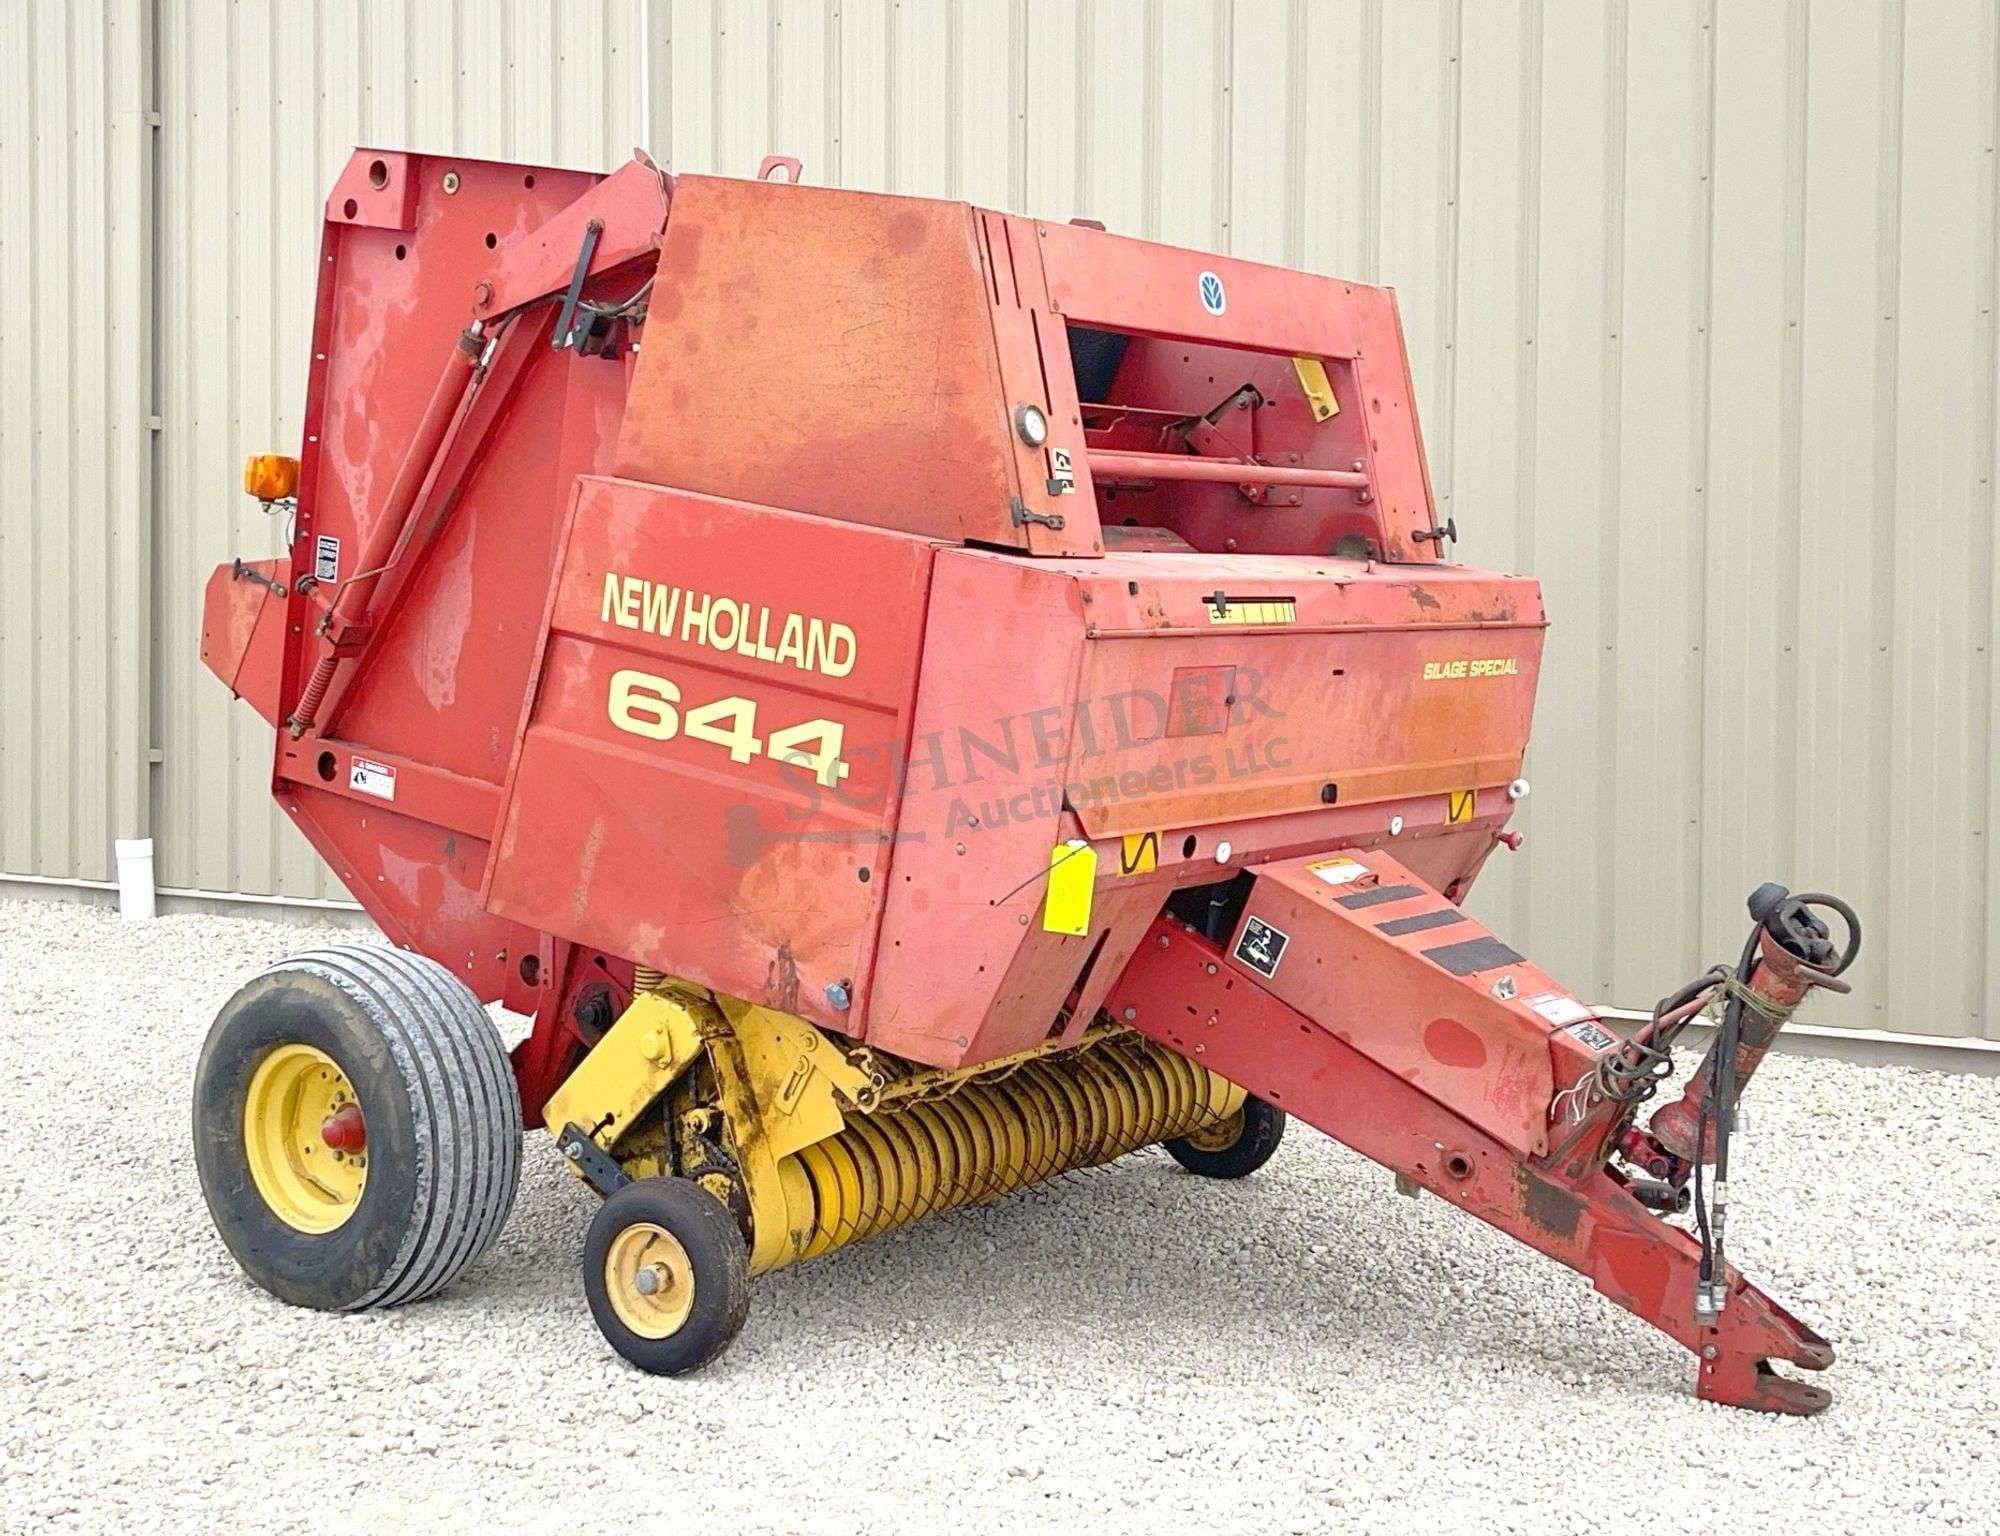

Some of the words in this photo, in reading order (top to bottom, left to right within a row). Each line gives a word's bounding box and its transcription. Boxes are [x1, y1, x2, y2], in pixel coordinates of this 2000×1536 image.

[601, 571, 680, 637] NEW
[681, 590, 857, 678] HOLLAND
[1423, 661, 1468, 680] SILAGE
[1469, 658, 1518, 677] SPECIAL
[608, 670, 850, 788] 644
